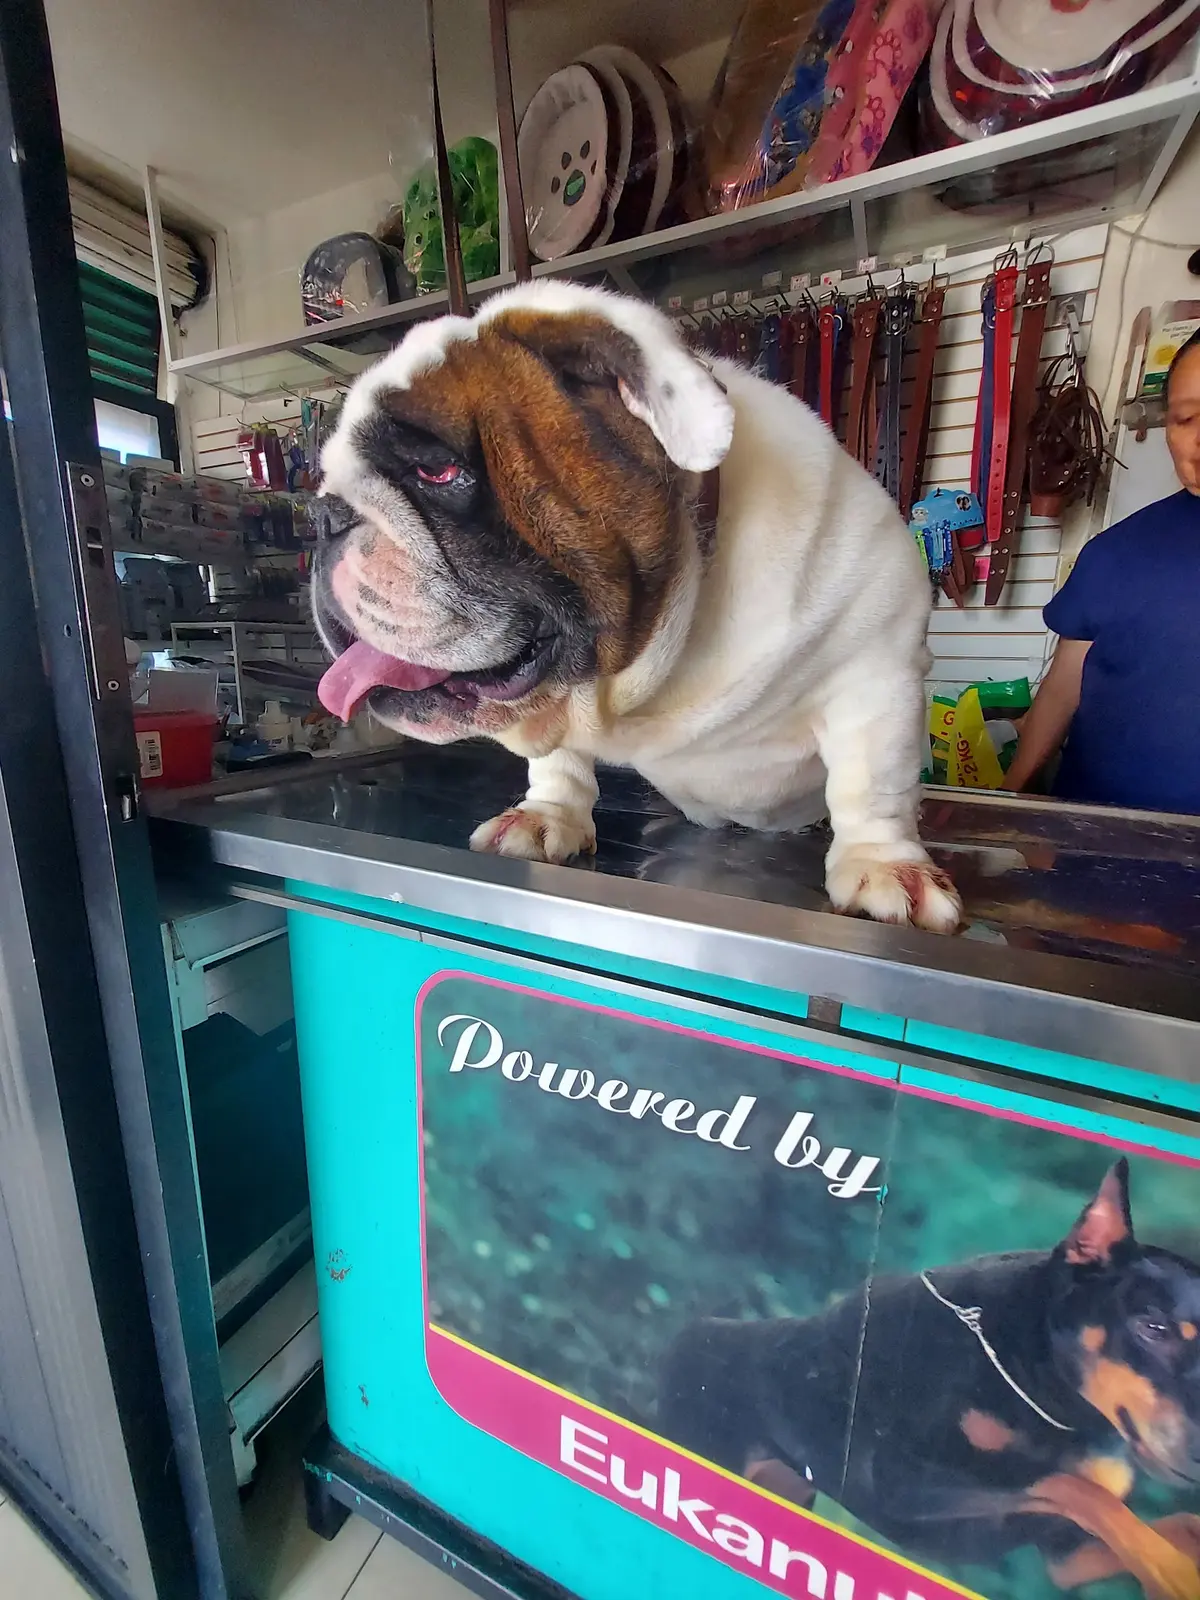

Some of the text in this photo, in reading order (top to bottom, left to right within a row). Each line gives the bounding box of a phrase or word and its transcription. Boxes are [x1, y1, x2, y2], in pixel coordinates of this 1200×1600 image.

[436, 1014, 883, 1198] Powered by
[559, 1413, 927, 1600] Eukan
